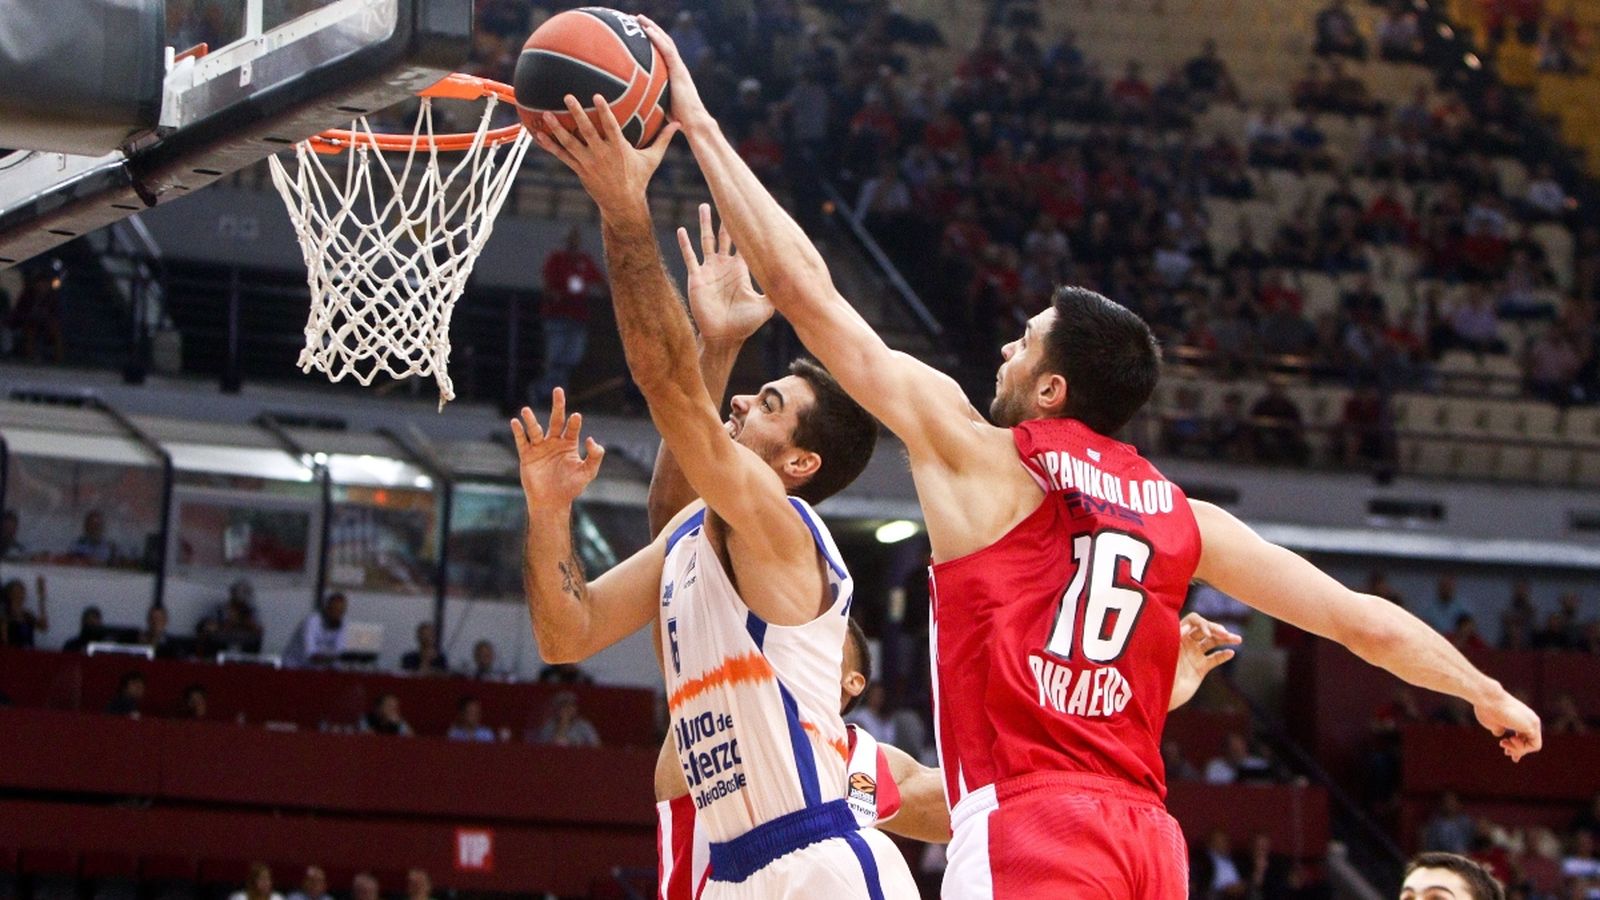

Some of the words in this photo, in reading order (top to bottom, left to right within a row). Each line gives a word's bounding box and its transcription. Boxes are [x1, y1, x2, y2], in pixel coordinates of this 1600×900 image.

[1031, 451, 1173, 514] PANIKOLAOU
[1045, 529, 1152, 664] 16
[1028, 654, 1132, 716] PIRAEUS
[716, 713, 733, 732] de
[459, 831, 490, 868] VIP
